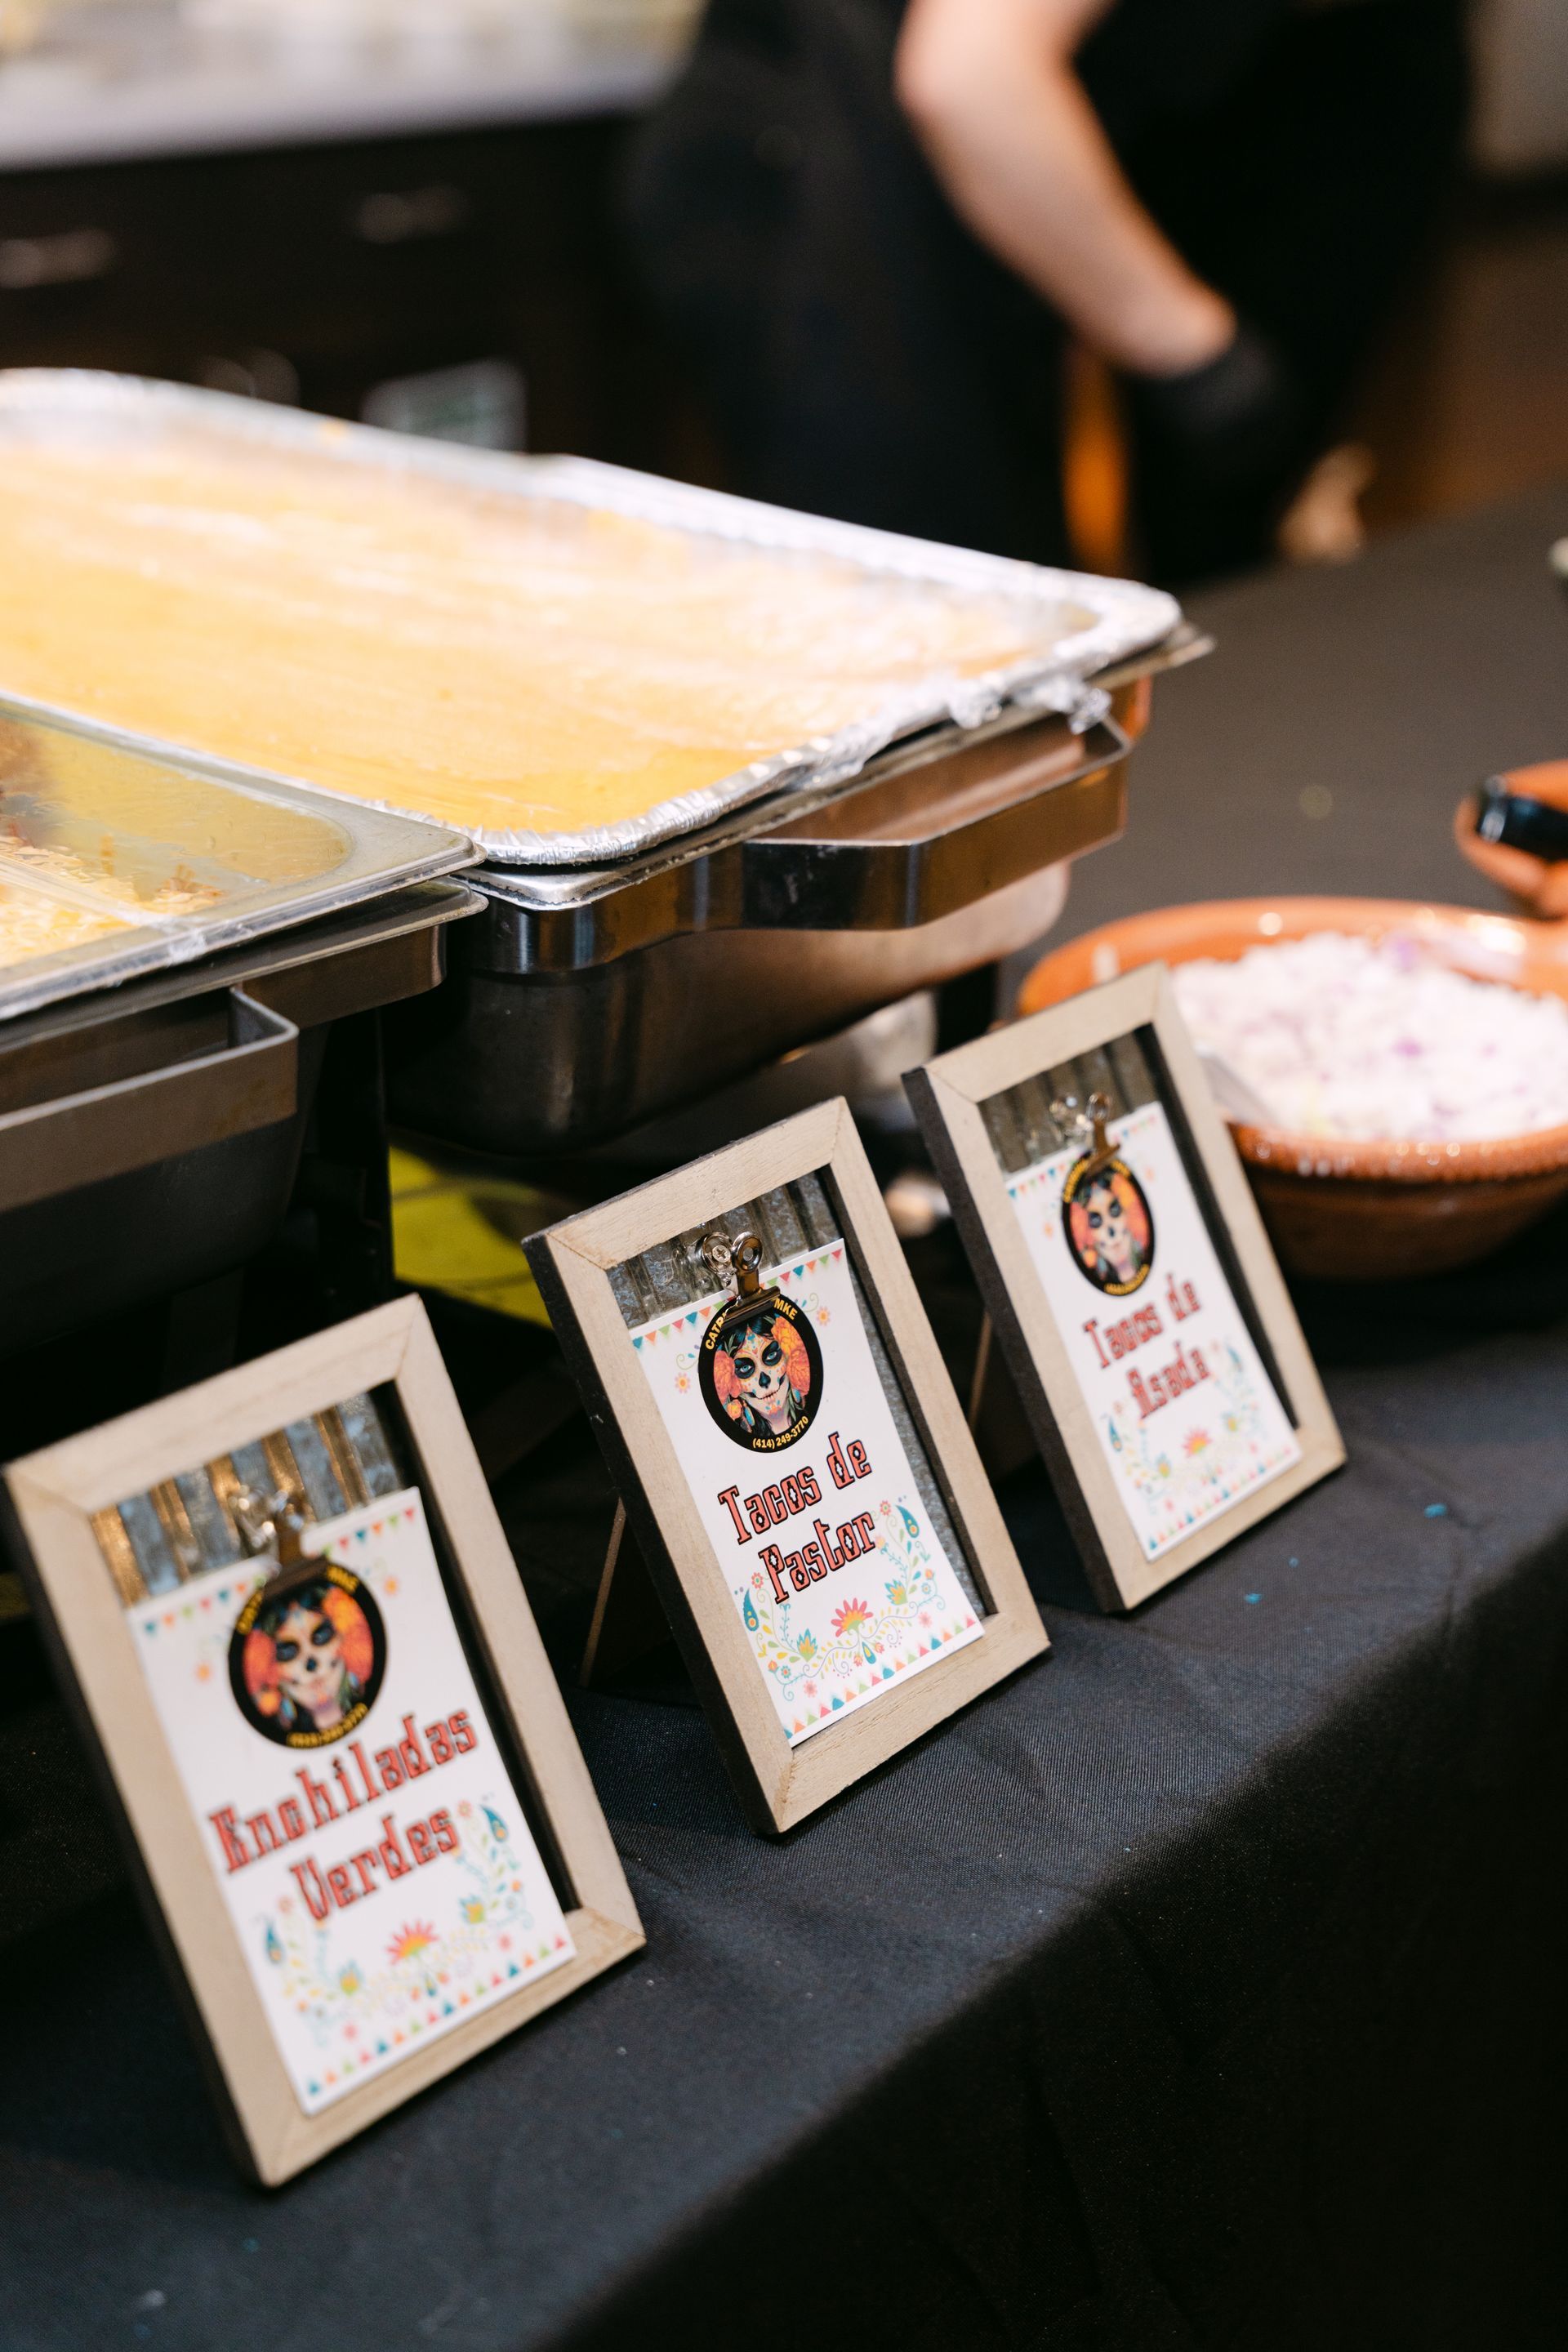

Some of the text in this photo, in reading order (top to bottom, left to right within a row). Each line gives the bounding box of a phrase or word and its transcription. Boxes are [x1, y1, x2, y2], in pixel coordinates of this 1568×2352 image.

[773, 1298, 798, 1321] MKE
[1083, 1304, 1163, 1369] Tacos
[752, 1415, 809, 1450] (414) 249-3770
[717, 1431, 872, 1545] Tacos de
[758, 1512, 876, 1604] Pastor
[209, 1710, 479, 1873] Enchiladas
[290, 1810, 459, 1920] Verdes
